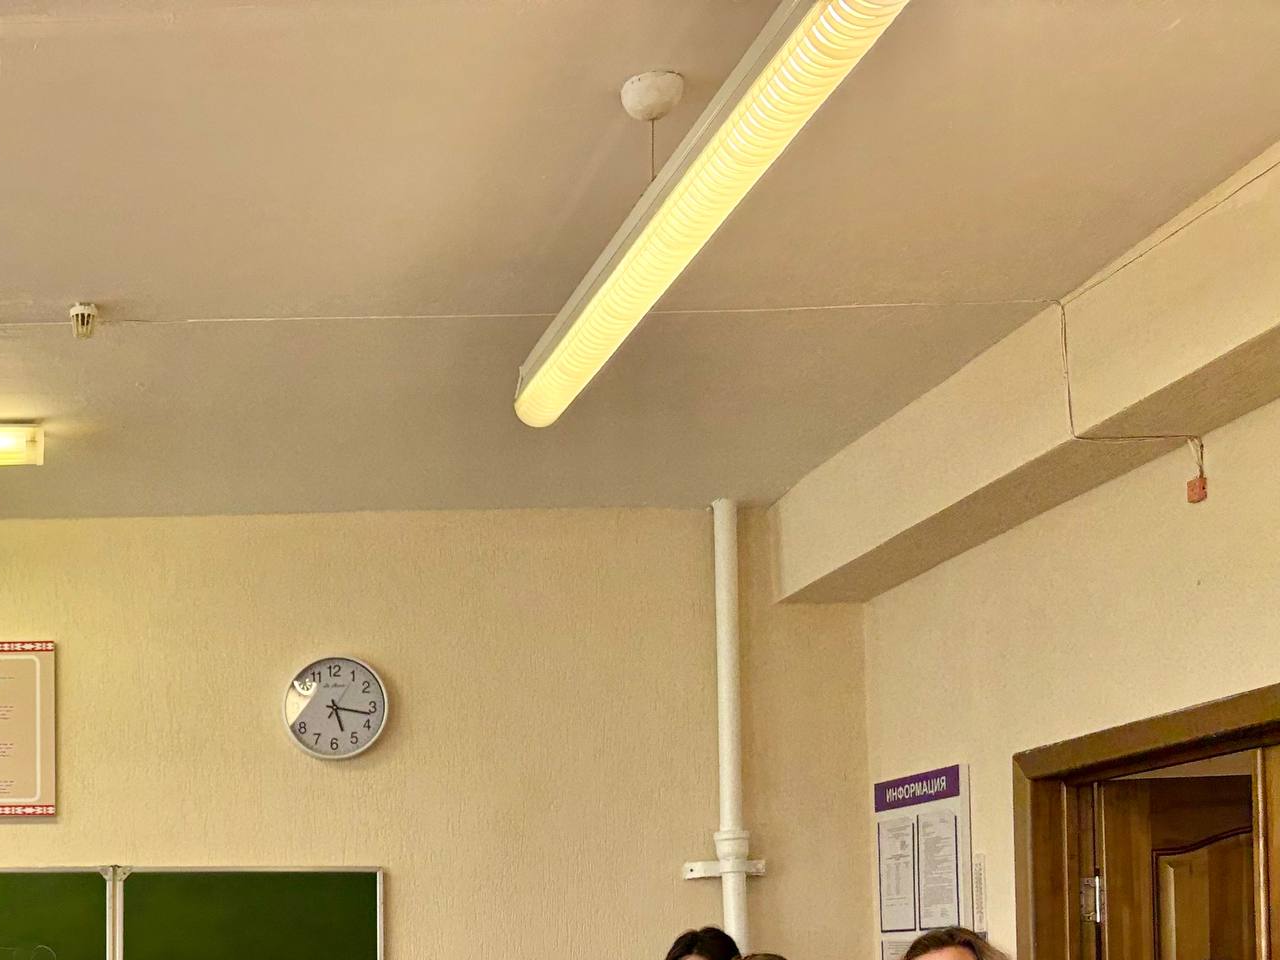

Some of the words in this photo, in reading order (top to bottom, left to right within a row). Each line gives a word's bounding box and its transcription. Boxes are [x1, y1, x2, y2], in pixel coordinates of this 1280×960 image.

[311, 671, 322, 683] 11
[328, 664, 341, 678] 12
[350, 670, 356, 682] 1
[362, 681, 371, 693] 2
[368, 701, 377, 714] 3
[298, 721, 307, 735] 8
[363, 719, 371, 730] 4
[313, 733, 322, 745] 7
[330, 738, 339, 750] 6
[350, 732, 358, 744] 5
[886, 776, 946, 803] ИНФОРМАЦИЯ
